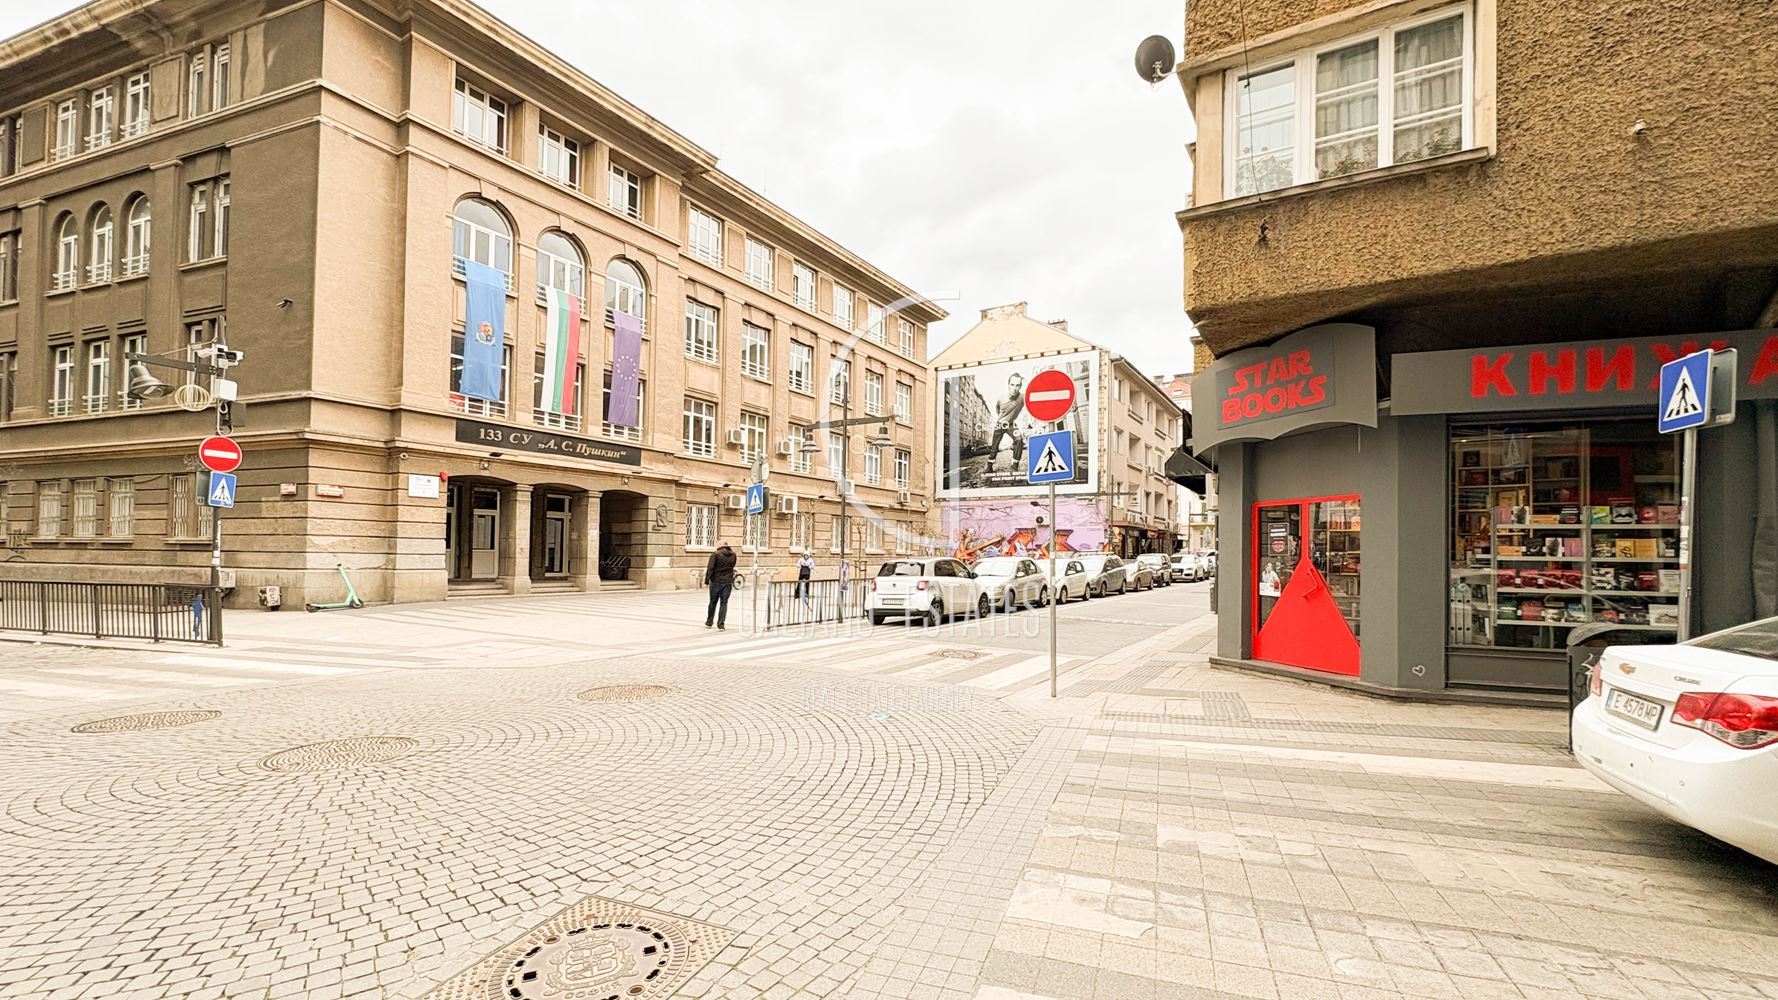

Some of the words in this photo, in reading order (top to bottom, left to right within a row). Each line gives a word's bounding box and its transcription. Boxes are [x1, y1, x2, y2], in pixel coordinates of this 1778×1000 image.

[1228, 349, 1313, 396] STAR
[1221, 374, 1328, 424] BOOKS
[479, 428, 501, 440] 133
[509, 432, 532, 444] СУ
[1614, 694, 1622, 708] E
[1623, 697, 1644, 717] 4578
